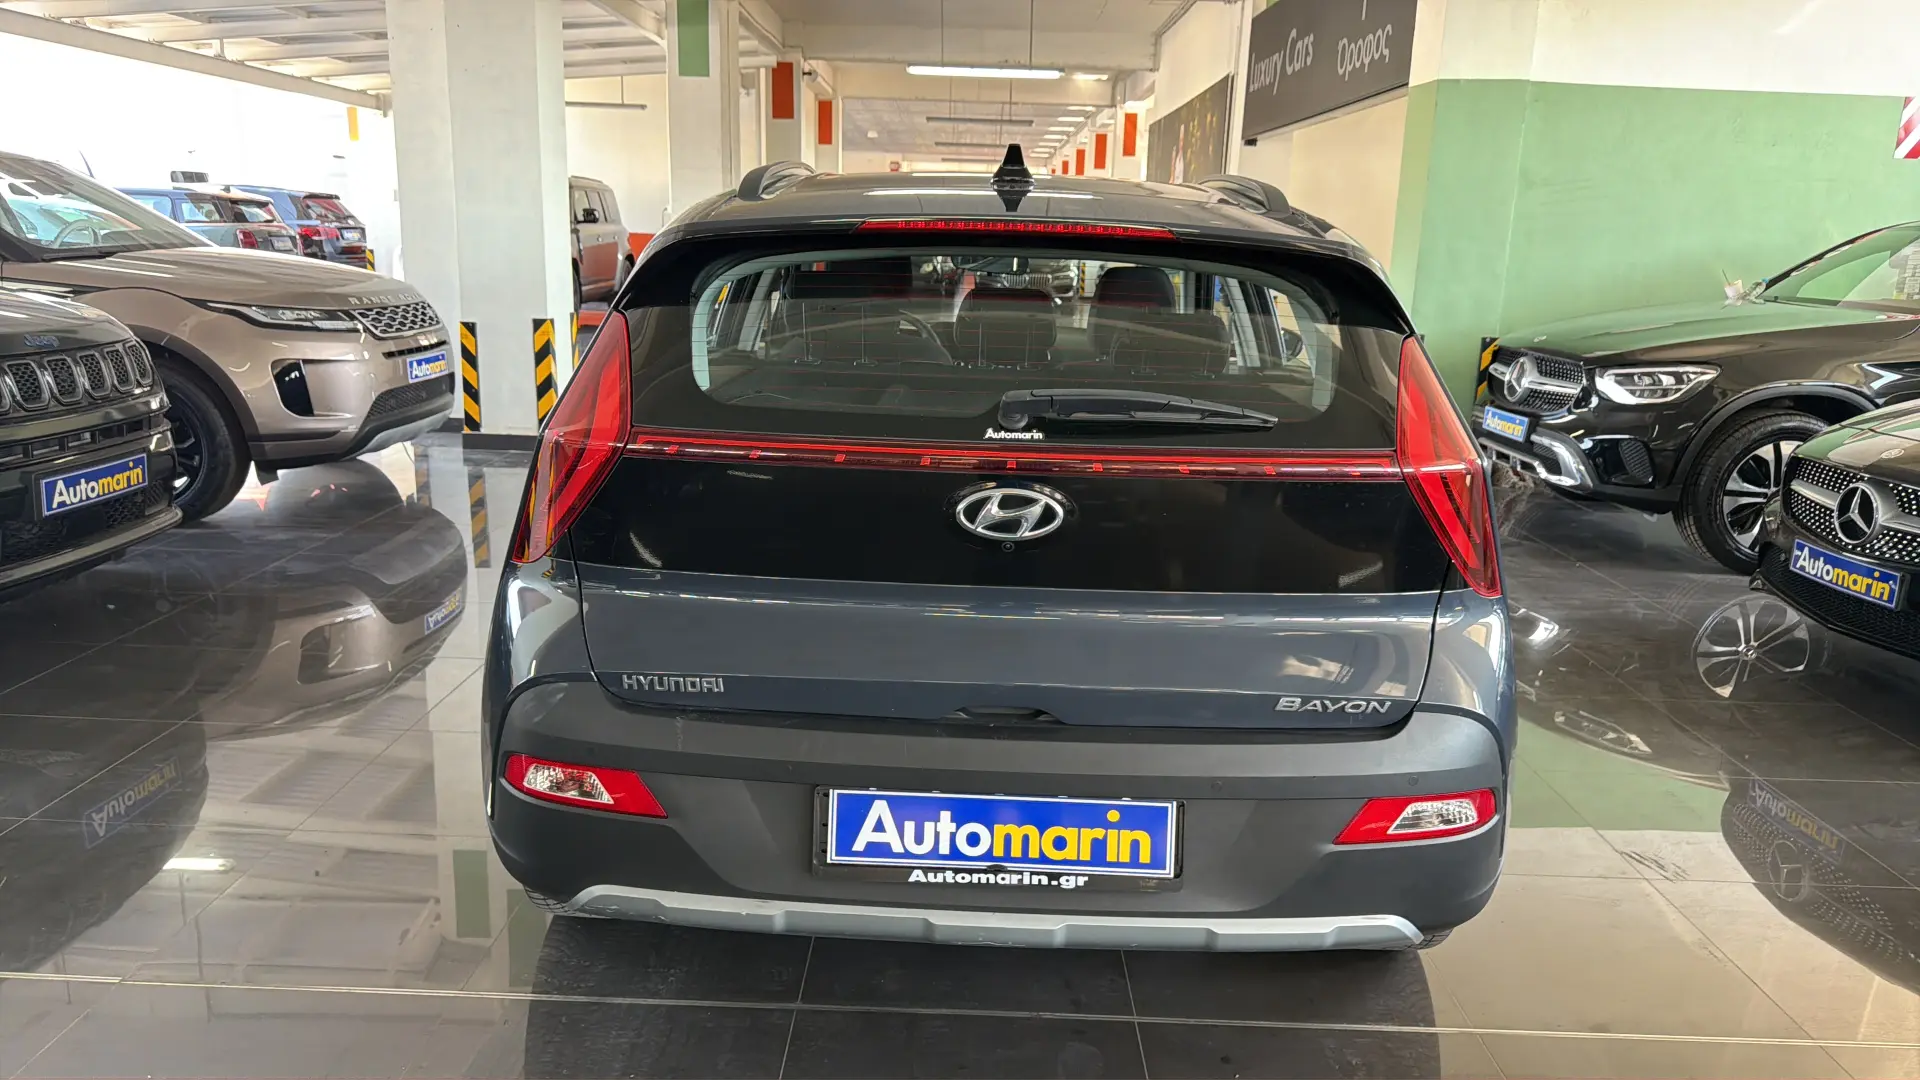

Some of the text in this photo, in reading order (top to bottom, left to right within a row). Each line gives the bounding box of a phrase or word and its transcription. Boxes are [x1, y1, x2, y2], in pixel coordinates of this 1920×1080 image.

[1249, 28, 1314, 95] Luxury Cars
[1337, 24, 1392, 81] Όροφος
[411, 355, 447, 379] Automarin
[983, 427, 1043, 439] Automarin
[1486, 410, 1523, 437] Automarin
[52, 461, 142, 509] Automarin
[1796, 546, 1890, 600] Automarin
[622, 674, 724, 692] HYUNDAI
[1274, 697, 1391, 714] BAYON
[852, 799, 1150, 863] Automarin
[907, 869, 1089, 888] Automarin.gr
